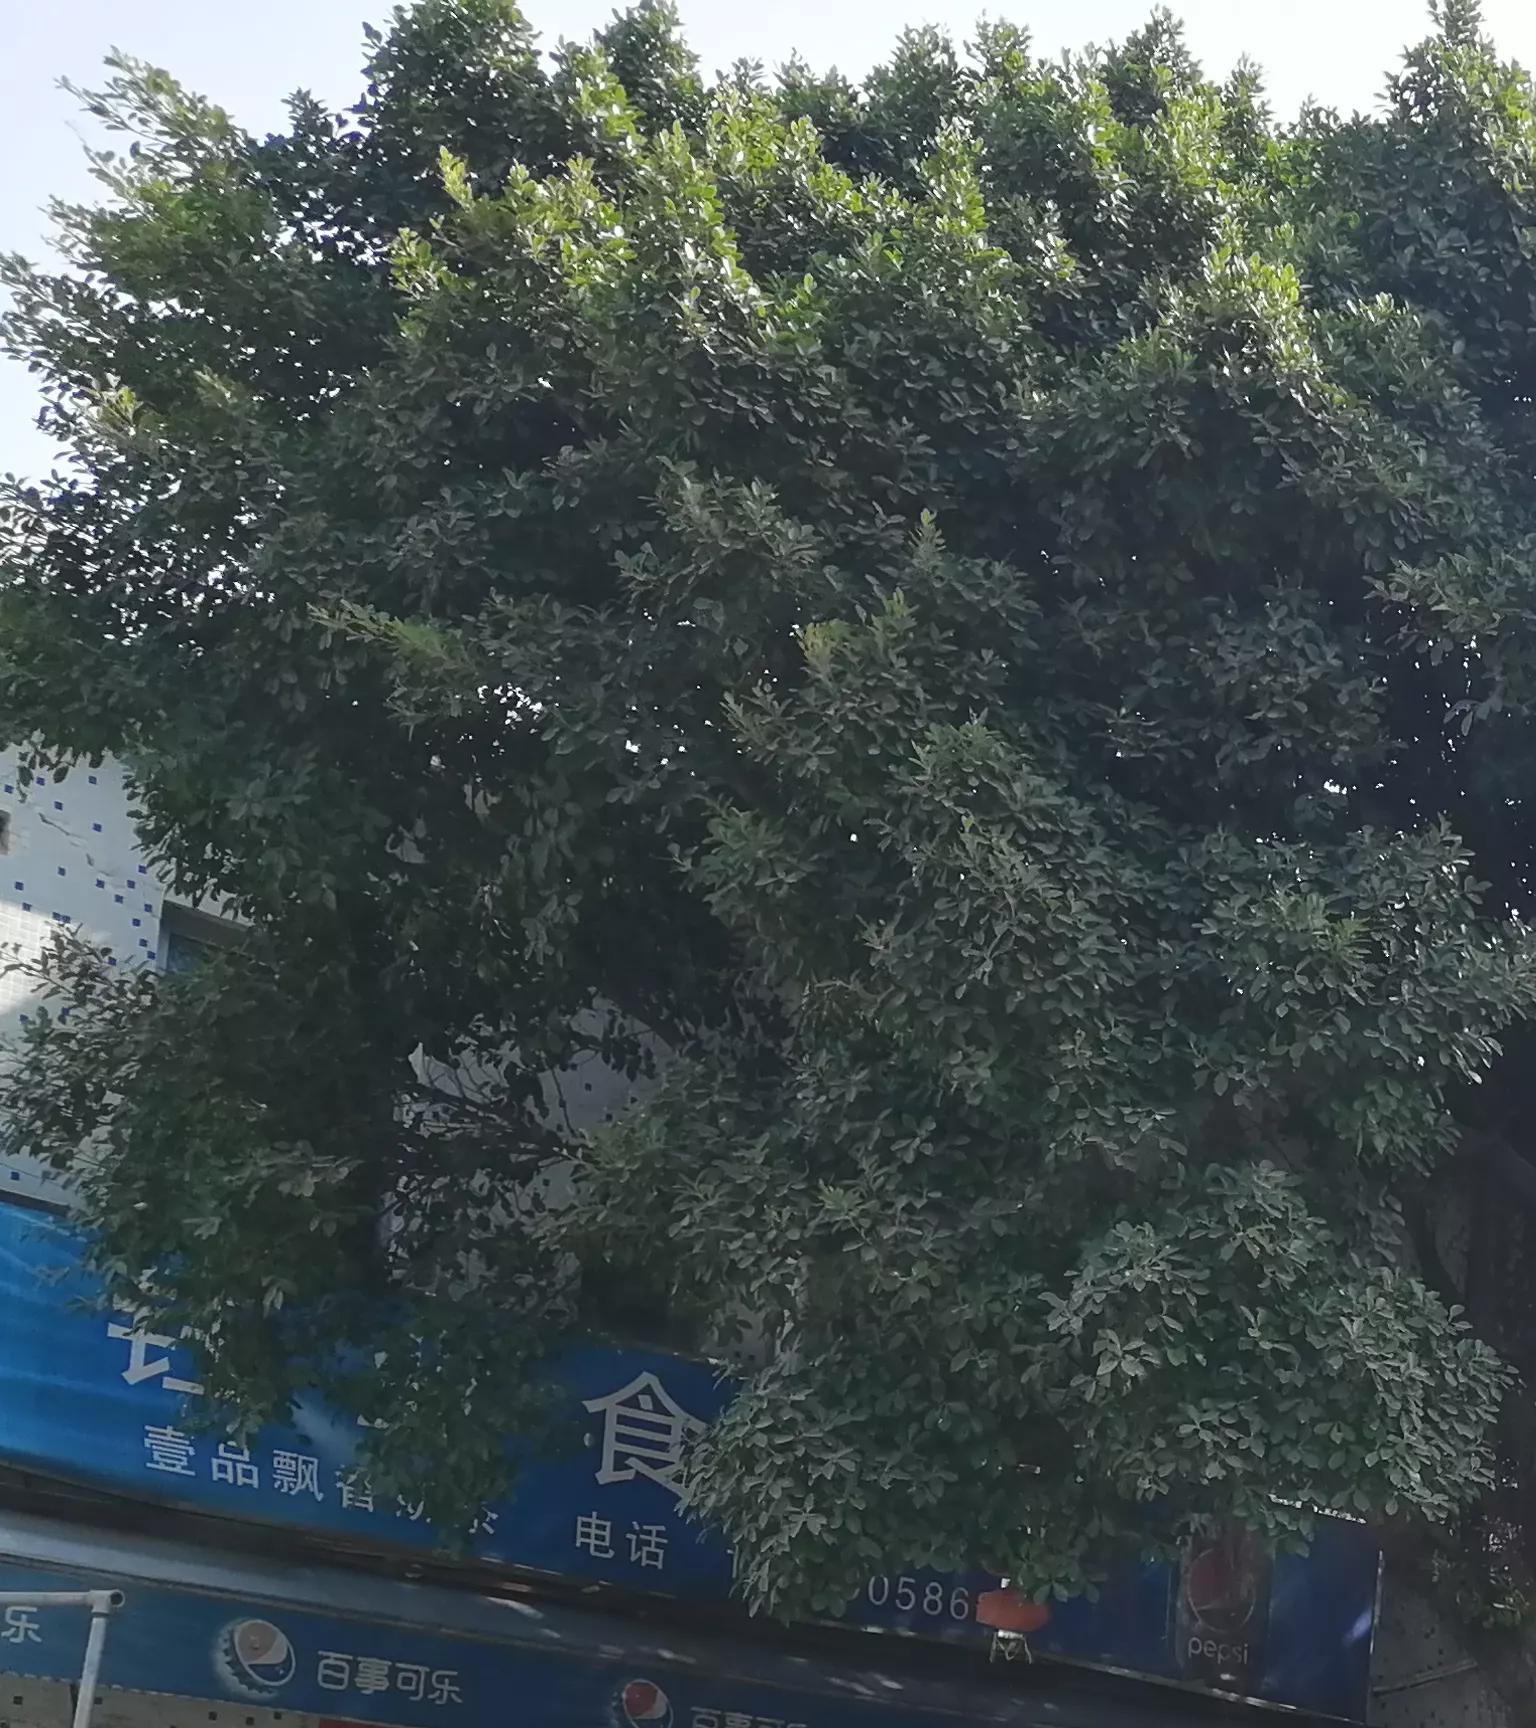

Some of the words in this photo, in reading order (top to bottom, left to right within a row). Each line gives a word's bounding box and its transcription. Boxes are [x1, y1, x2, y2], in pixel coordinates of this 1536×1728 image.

[574, 1511, 669, 1570] 电话
[317, 1650, 463, 1705] 百事可乐
[1186, 1635, 1249, 1666] pepsi
